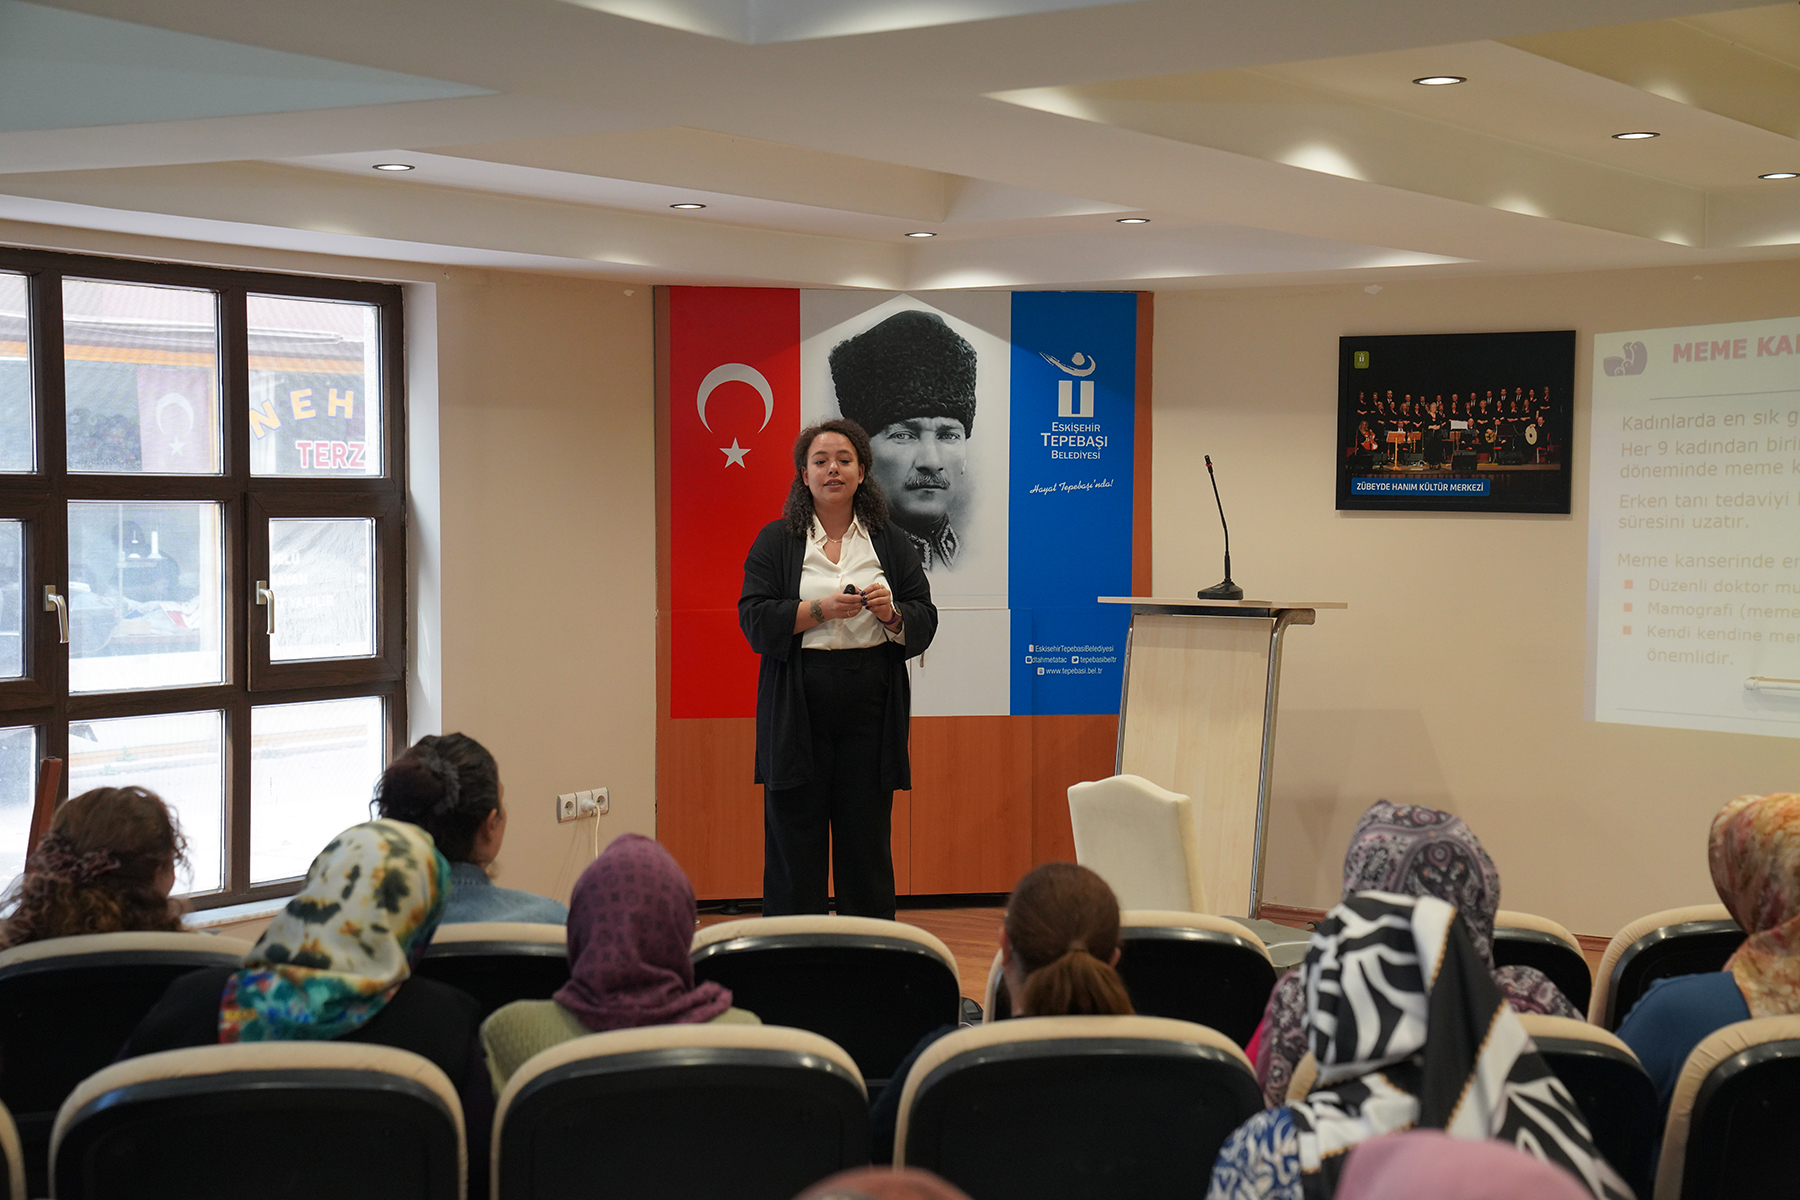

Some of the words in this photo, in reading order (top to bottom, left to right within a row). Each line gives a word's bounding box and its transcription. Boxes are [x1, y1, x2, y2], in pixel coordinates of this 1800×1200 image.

[1672, 338, 1747, 363] MEME
[1051, 421, 1101, 434] ESKİŞEHİR
[1622, 413, 1716, 431] Kadınlarda
[1723, 413, 1745, 427] en
[1752, 408, 1779, 425] sık
[1040, 432, 1108, 450] TEPEBAŞI
[1621, 442, 1651, 457] Her
[1657, 440, 1668, 456] 9
[1675, 438, 1758, 455] kadından
[1051, 450, 1101, 459] BELEDİYESİ
[1620, 461, 1718, 478] döneminde
[1725, 462, 1784, 476] meme
[1029, 482, 1057, 495] Hayat
[1356, 481, 1391, 491] ZÜBEYDE
[1392, 482, 1418, 491] HANIM
[1419, 481, 1449, 491] KÜLTÜR
[1450, 482, 1484, 492] MERKEZİ
[1619, 494, 1668, 509] Erken
[1675, 493, 1708, 508] tanı
[1715, 492, 1789, 510] tedaviyi
[1618, 514, 1685, 529] süresini
[1692, 515, 1749, 529] uzatır.
[1617, 553, 1668, 567] Meme
[1675, 553, 1775, 568] kanserinde
[1648, 578, 1708, 592] Düzenli
[1713, 579, 1769, 593] doktor
[1647, 602, 1733, 618] Mamografi
[1647, 625, 1691, 639] Kendi
[1697, 626, 1762, 642] kendine
[1646, 647, 1734, 665] önemlidir.
